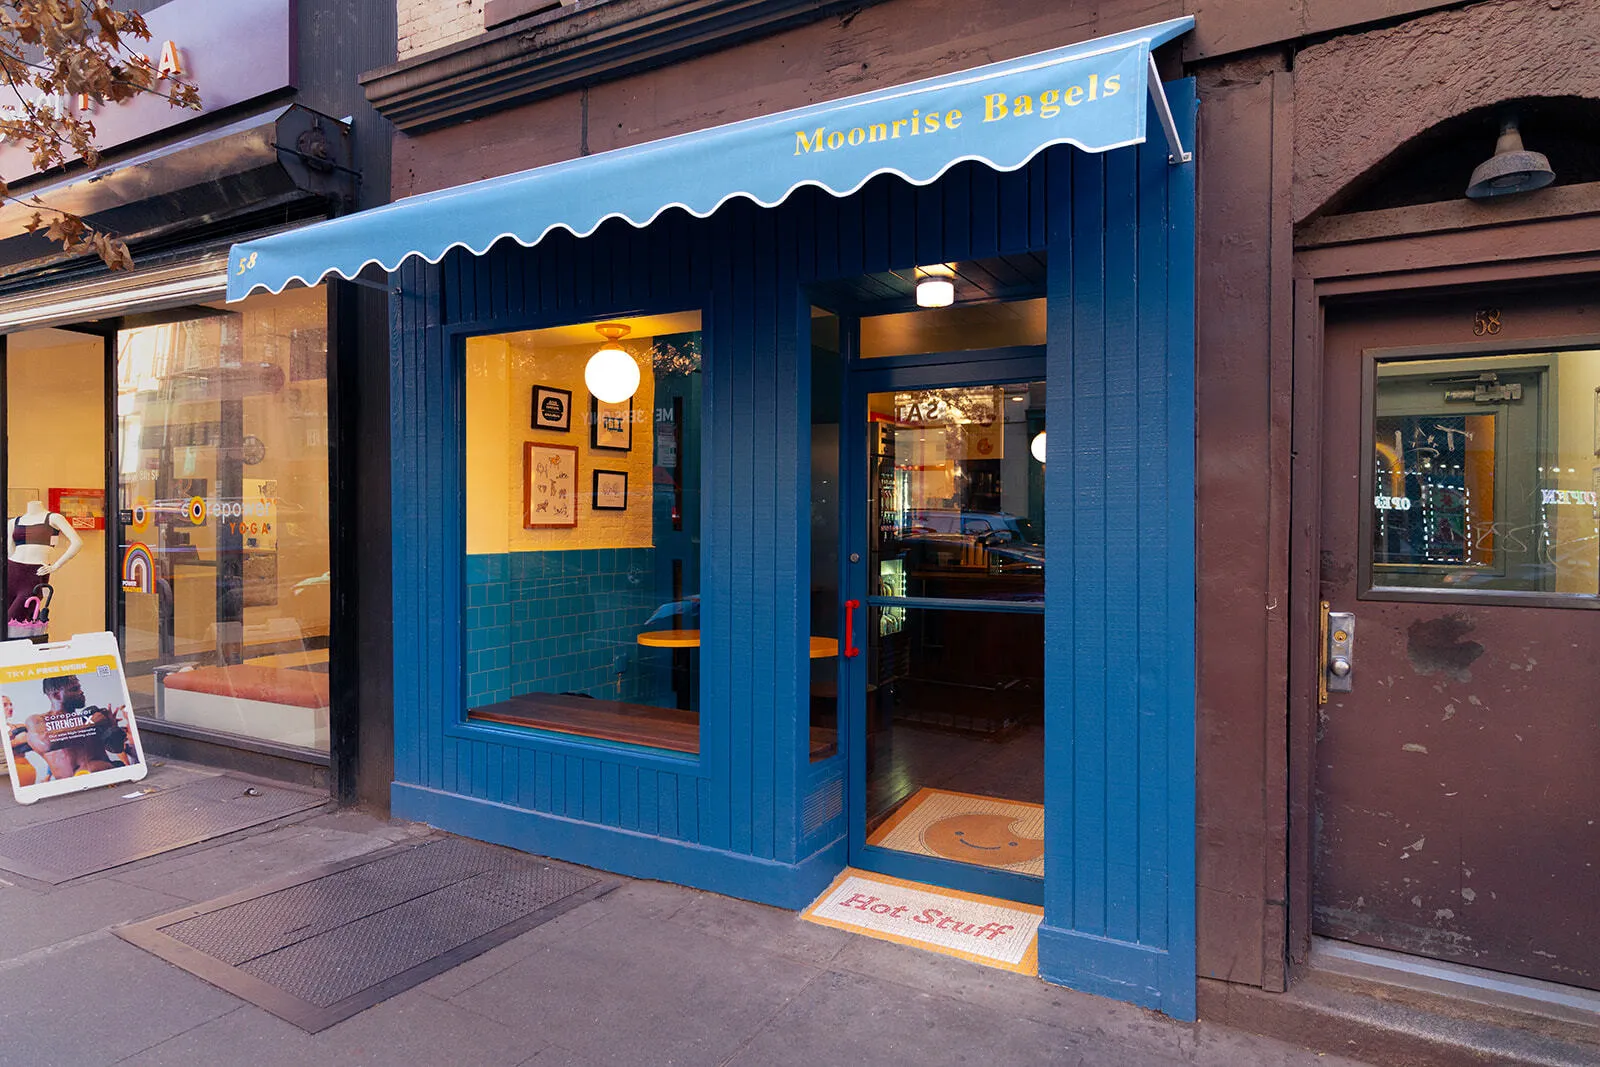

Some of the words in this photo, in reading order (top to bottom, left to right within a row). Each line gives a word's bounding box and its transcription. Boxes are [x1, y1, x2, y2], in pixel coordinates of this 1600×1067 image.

[793, 105, 962, 156] Moonrise
[983, 72, 1122, 123] Bagels
[236, 251, 258, 276] 58
[1472, 309, 1502, 336] 58
[230, 522, 269, 535] YOGA
[7, 671, 25, 679] TRY
[45, 709, 92, 721] corepower
[45, 717, 84, 732] STRENGTH
[83, 715, 95, 726] X
[839, 892, 909, 918] Hot
[913, 907, 1015, 941] Stuff
